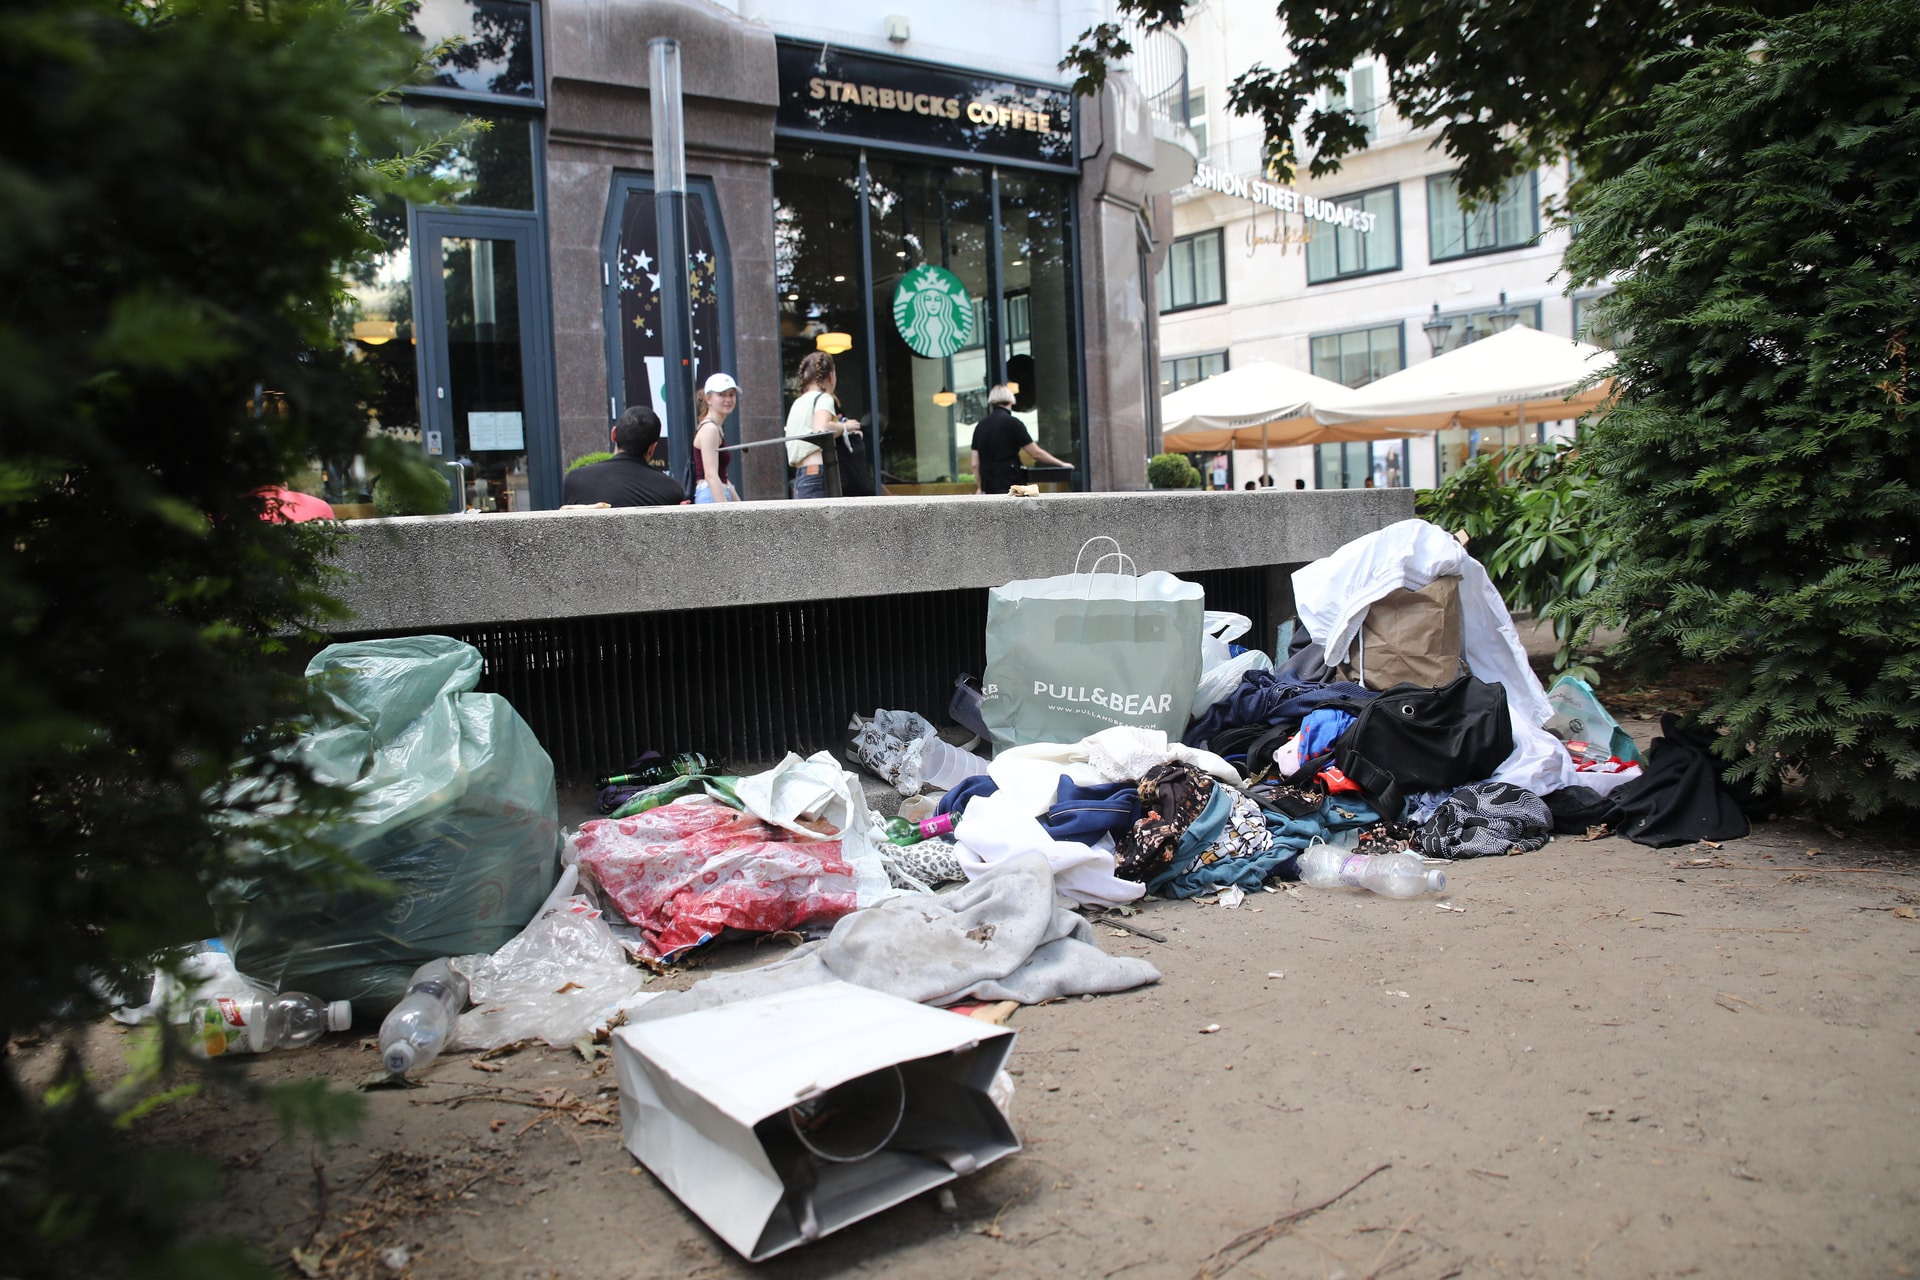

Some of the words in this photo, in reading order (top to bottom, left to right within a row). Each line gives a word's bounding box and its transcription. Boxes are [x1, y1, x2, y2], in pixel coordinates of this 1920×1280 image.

[809, 77, 960, 120] STARBUCKS
[966, 101, 1052, 134] COFFEE
[1193, 163, 1248, 199] SHION
[1252, 180, 1301, 214] STREET
[1303, 195, 1376, 233] BUDAPEST
[1033, 680, 1173, 716] PULL&BEAR
